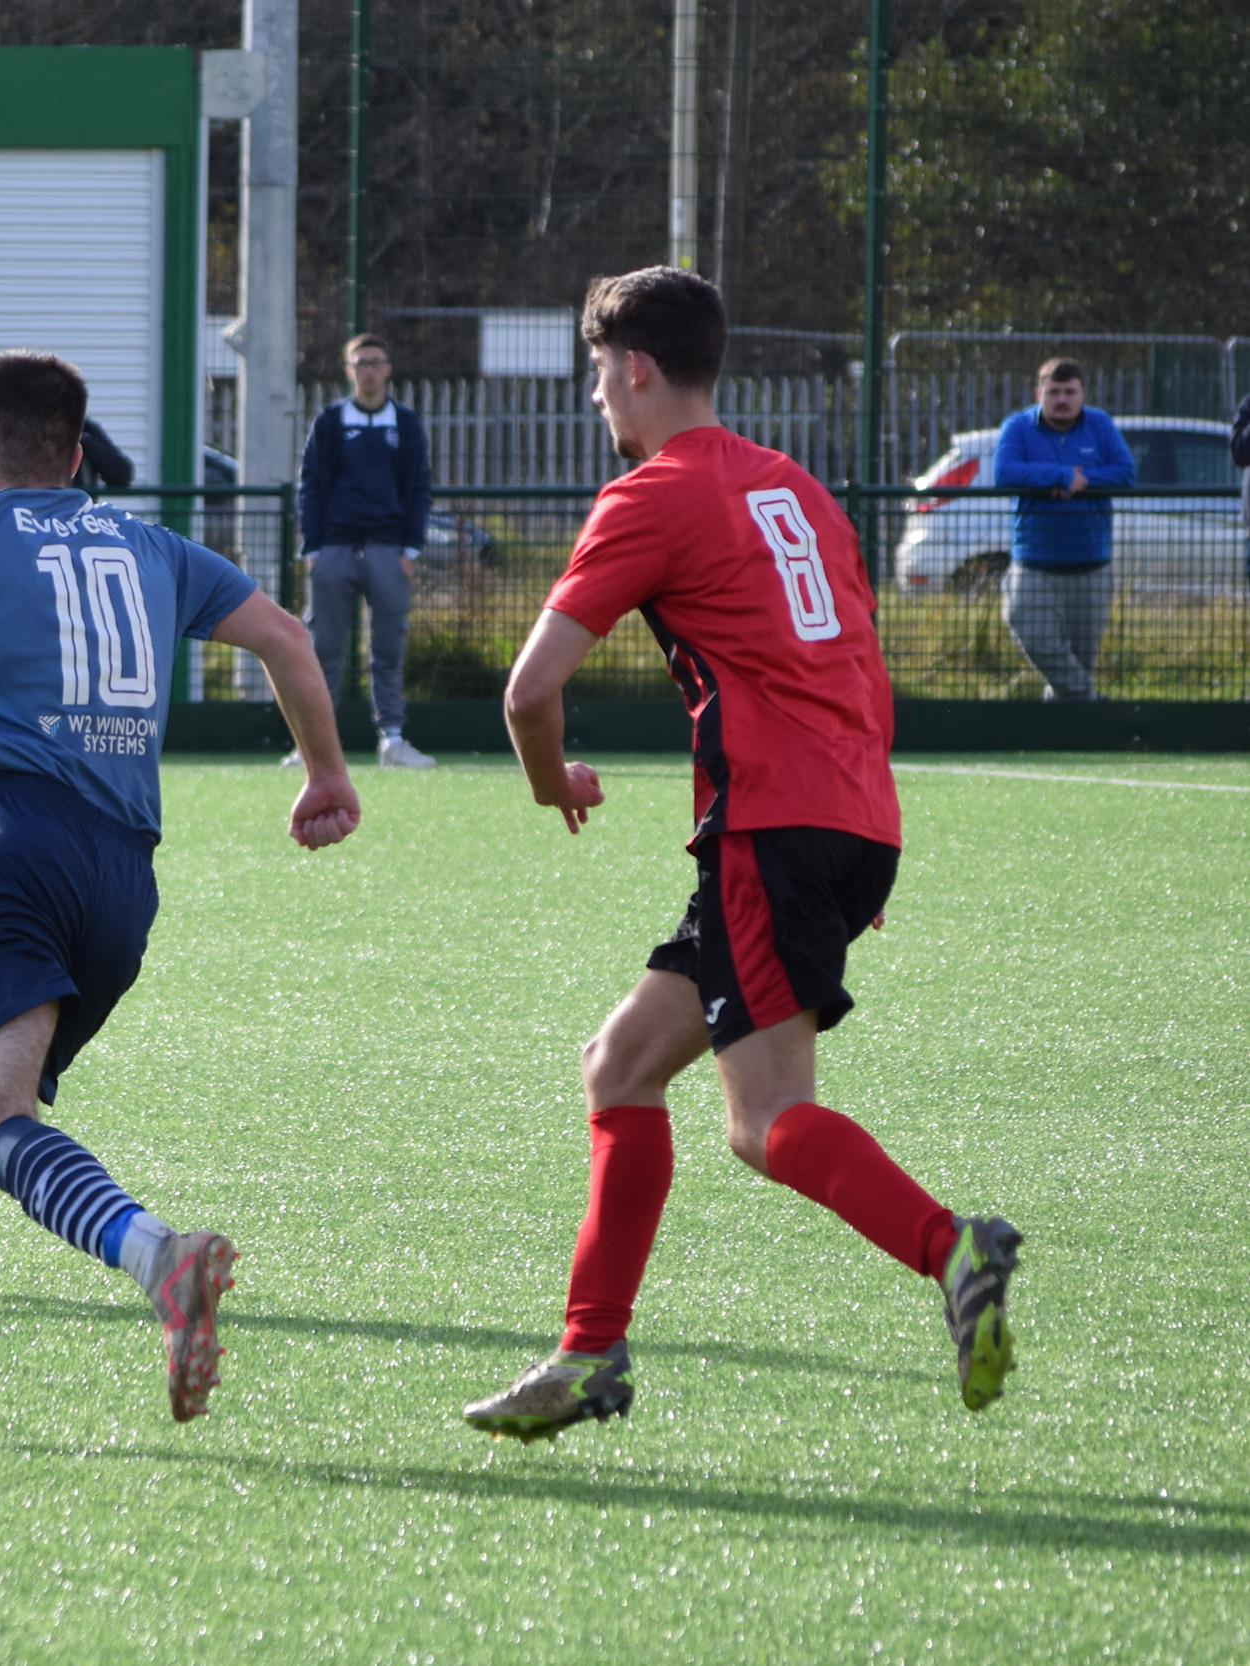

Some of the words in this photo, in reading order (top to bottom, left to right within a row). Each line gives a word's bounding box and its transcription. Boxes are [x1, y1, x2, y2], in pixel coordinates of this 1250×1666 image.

[13, 507, 126, 539] Everest
[747, 487, 842, 641] 8
[36, 544, 157, 708] 10
[68, 714, 92, 734] W2
[97, 716, 158, 738] WINDOW
[84, 734, 146, 756] SYSTEMS
